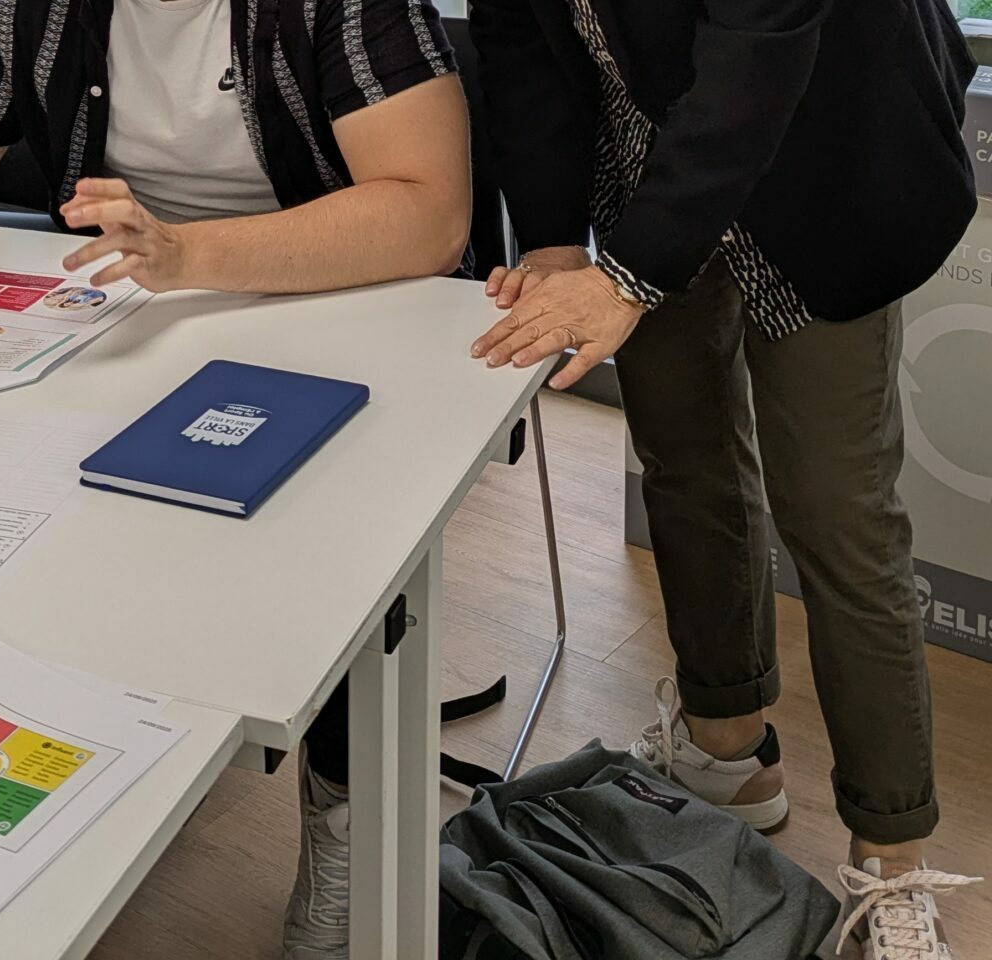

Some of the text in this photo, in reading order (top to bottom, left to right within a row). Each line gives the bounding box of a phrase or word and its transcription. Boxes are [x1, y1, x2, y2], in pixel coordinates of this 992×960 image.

[936, 263, 983, 285] NDS
[193, 421, 248, 436] SPORT
[235, 420, 255, 428] DANS
[934, 600, 992, 639] ELI
